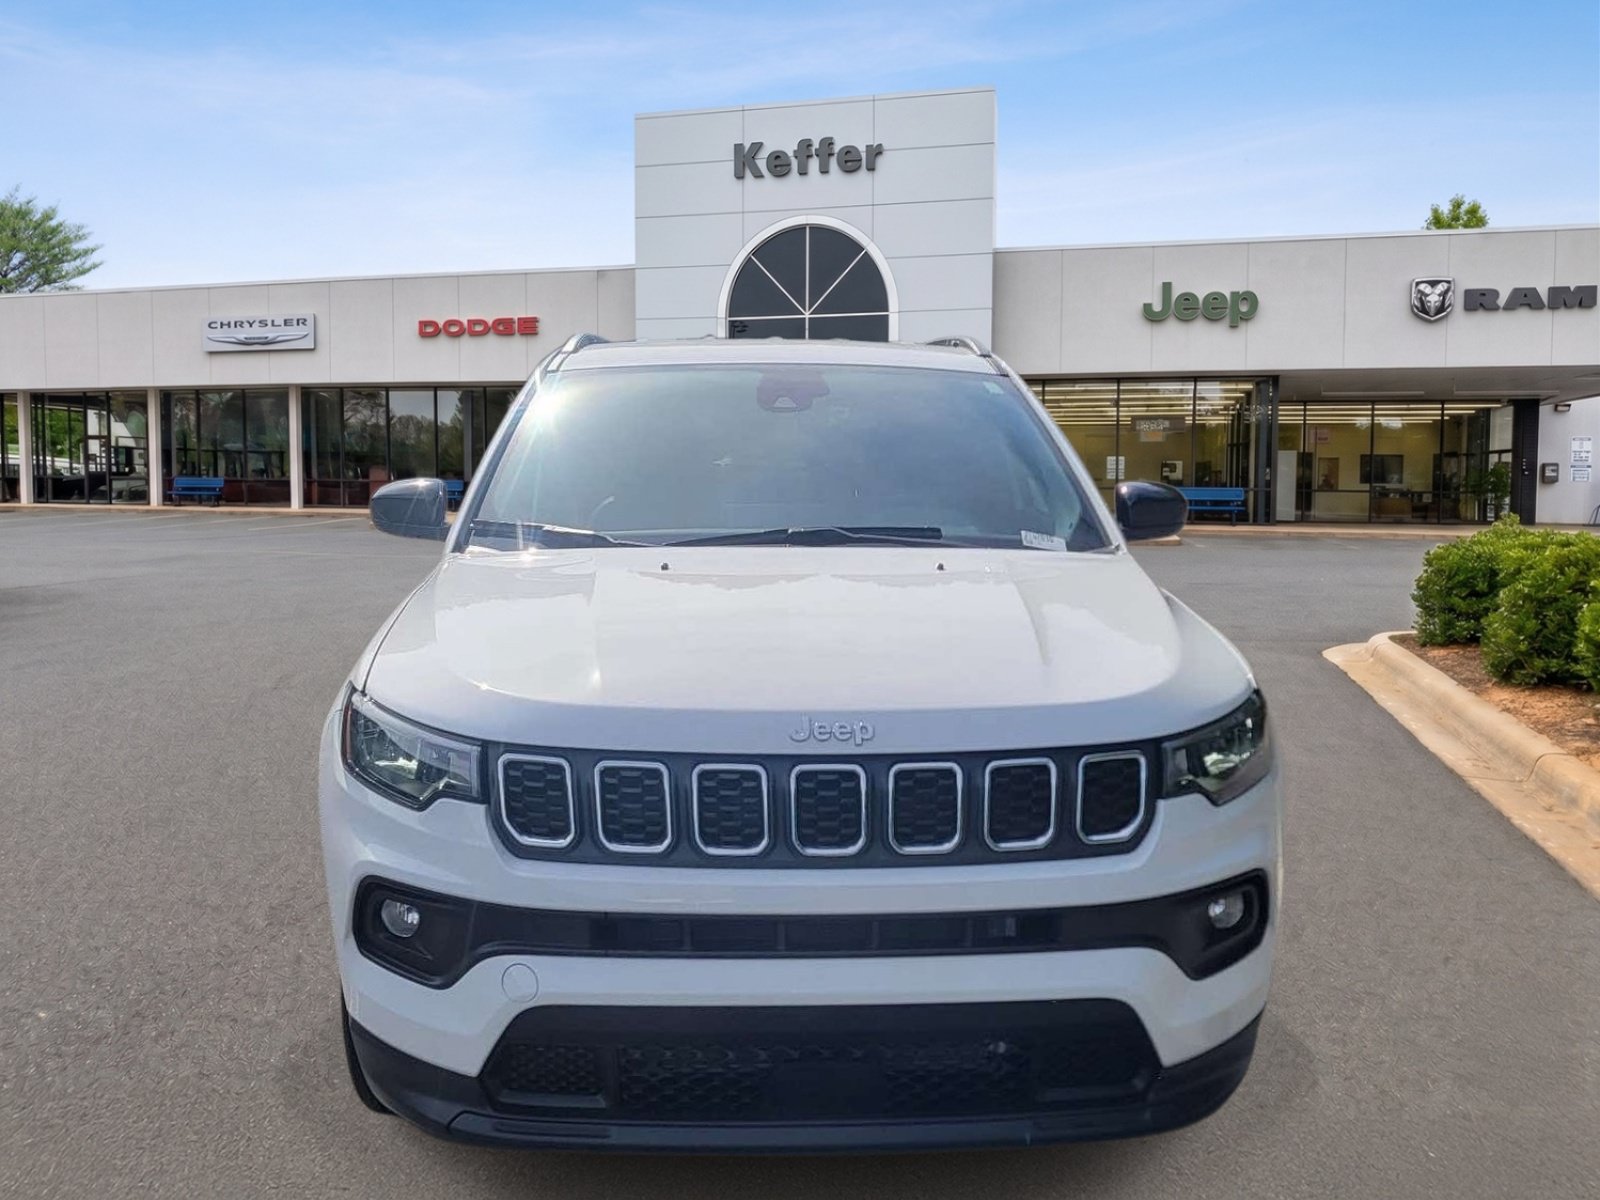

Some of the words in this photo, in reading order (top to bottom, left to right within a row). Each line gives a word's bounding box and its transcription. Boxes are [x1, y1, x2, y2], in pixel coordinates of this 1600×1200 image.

[734, 137, 883, 179] Keffer
[1143, 281, 1259, 328] Jeep
[1464, 285, 1598, 311] RAM
[207, 318, 308, 329] CHRYSLER
[418, 316, 539, 337] DODGE
[790, 714, 875, 747] Jeep
